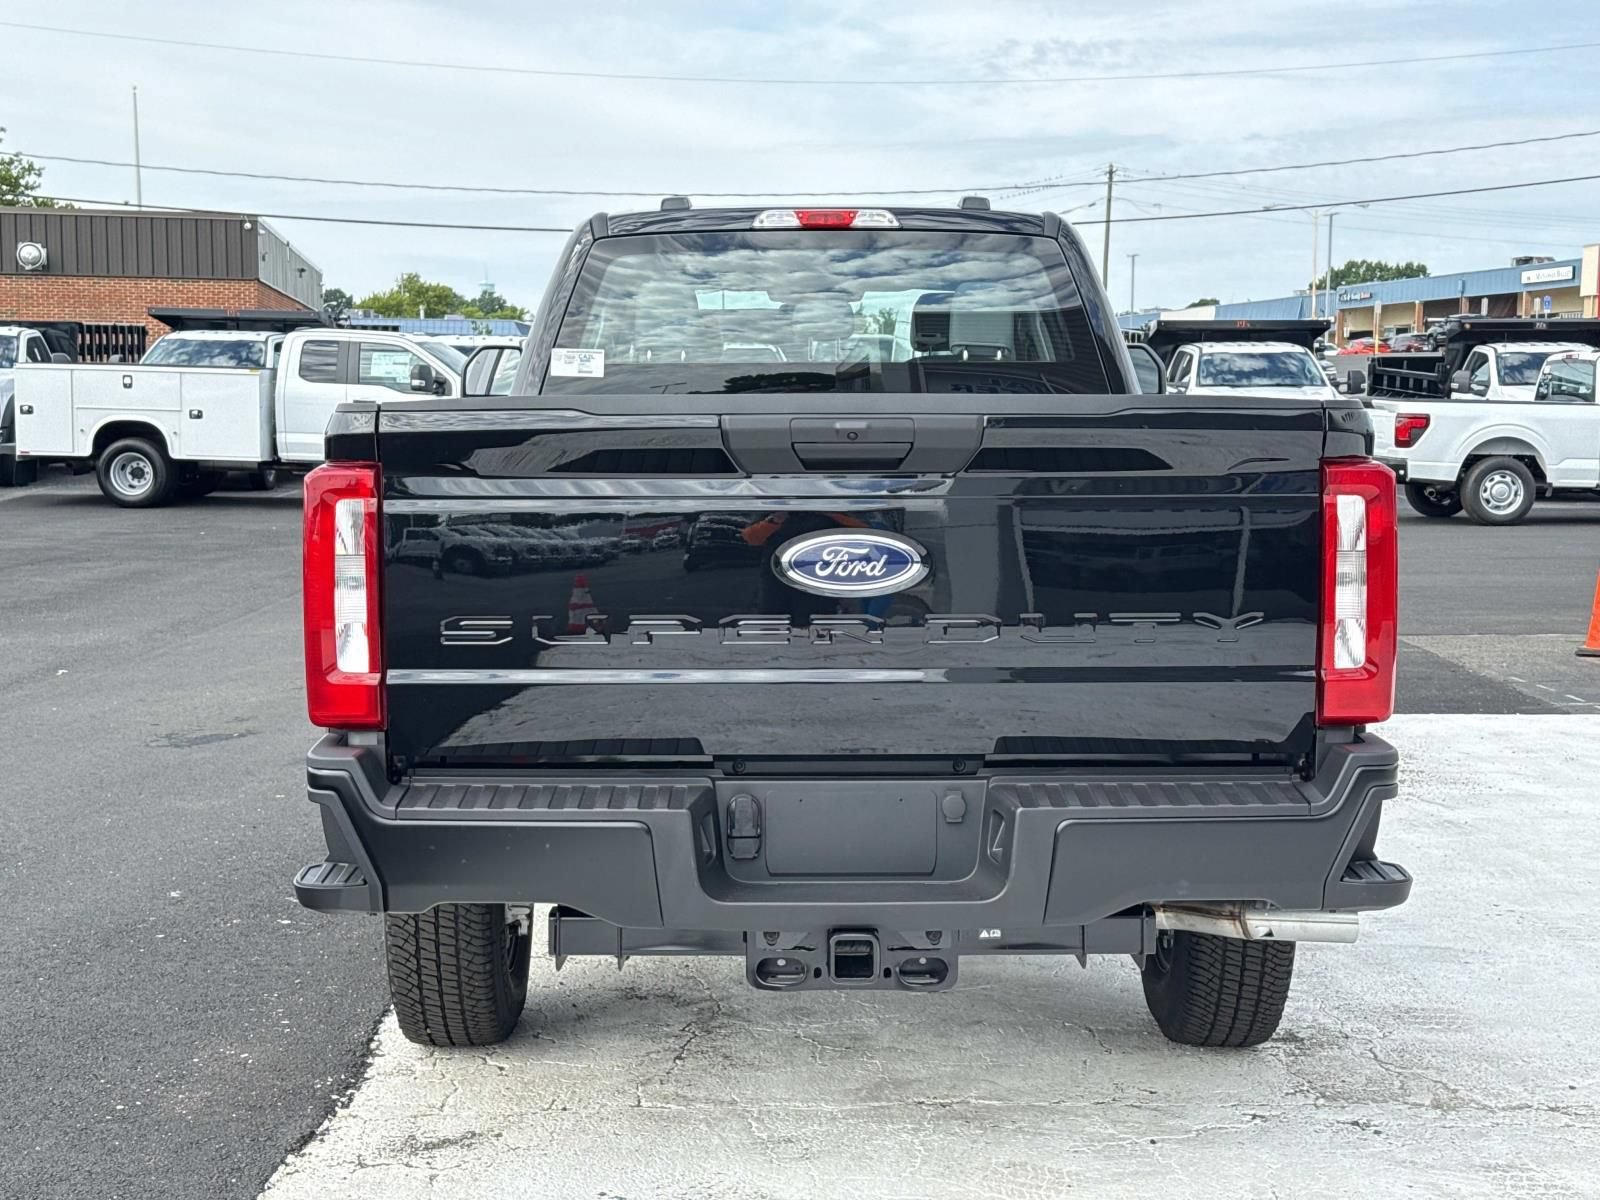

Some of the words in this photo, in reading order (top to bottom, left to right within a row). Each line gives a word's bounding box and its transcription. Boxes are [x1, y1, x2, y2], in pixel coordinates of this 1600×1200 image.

[815, 546, 889, 577] Ford
[440, 614, 885, 646] SUPER
[924, 612, 1265, 644] DUTY
